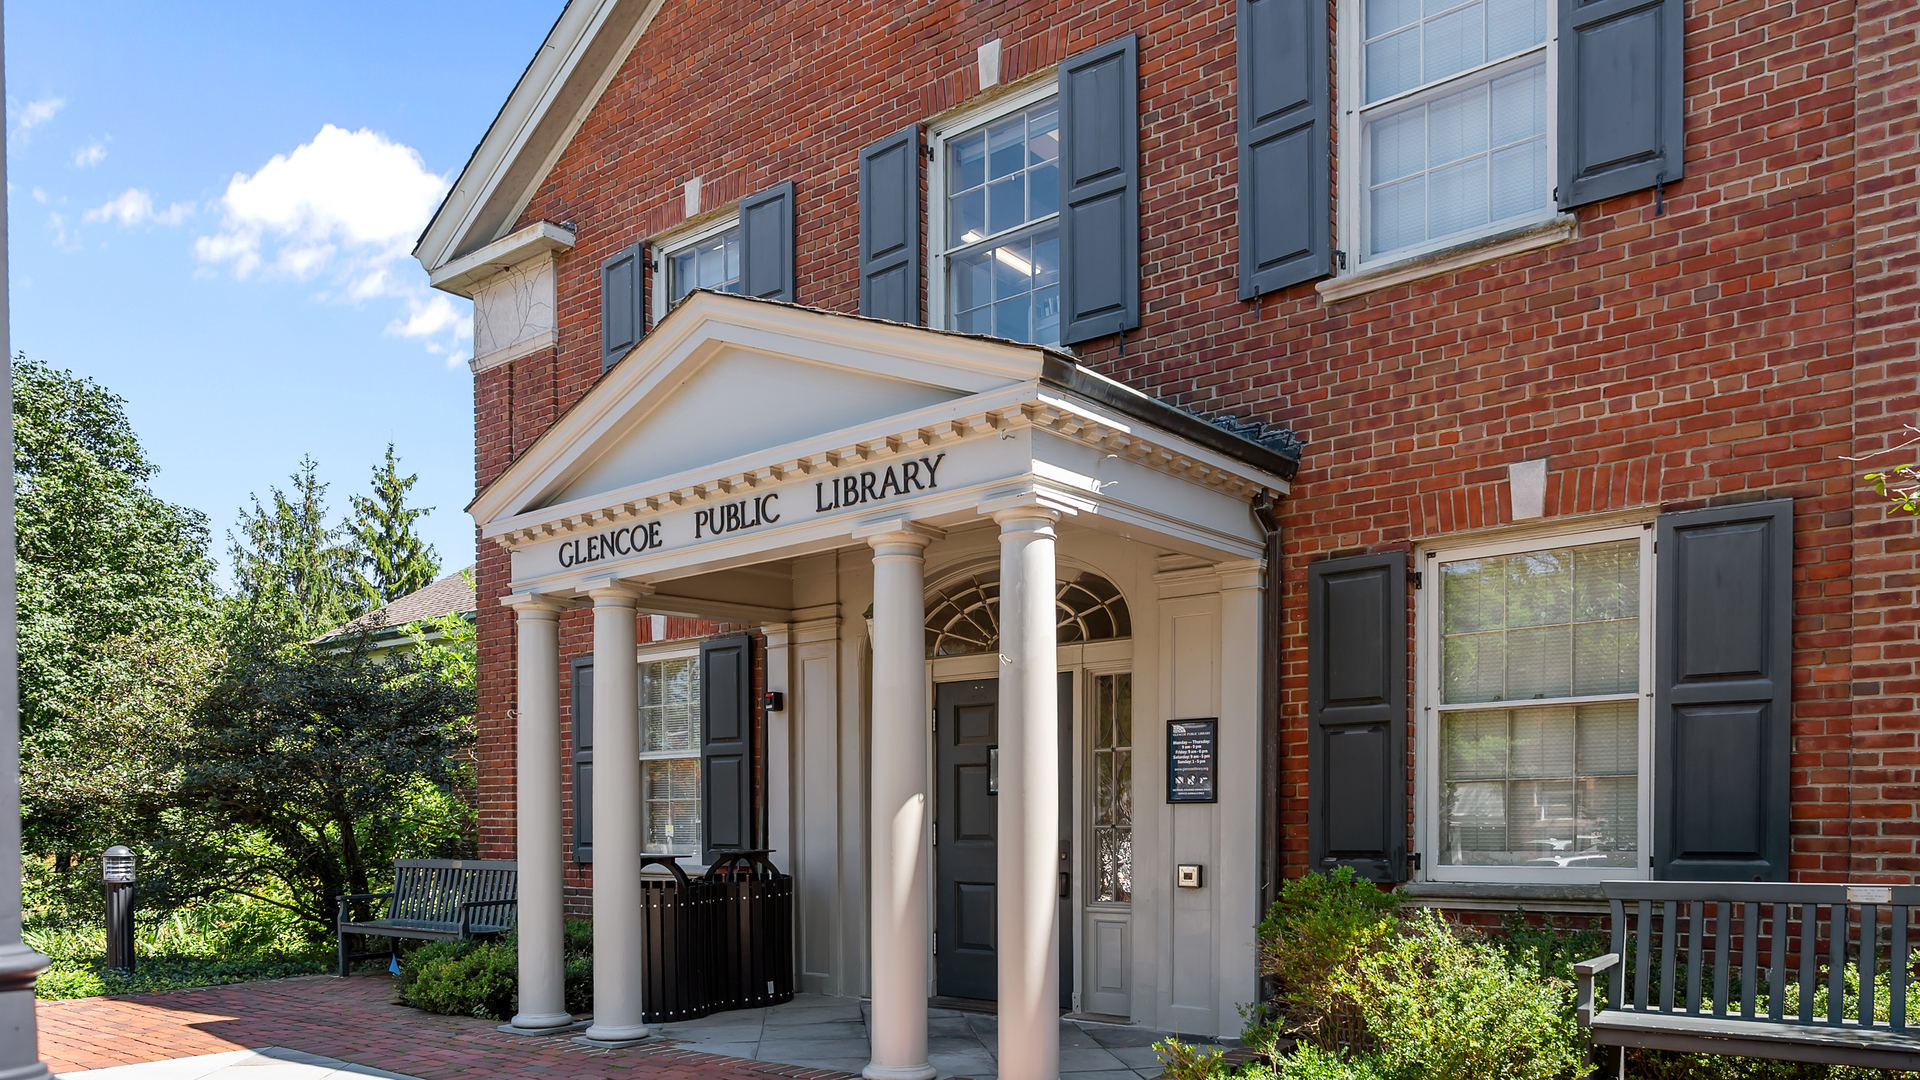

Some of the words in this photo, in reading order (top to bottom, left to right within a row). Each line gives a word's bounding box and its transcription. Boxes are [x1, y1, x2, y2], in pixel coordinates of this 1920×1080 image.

[558, 521, 662, 568] GLENCOE
[694, 494, 780, 539] PUBLIC
[815, 453, 946, 513] LIBRARY
